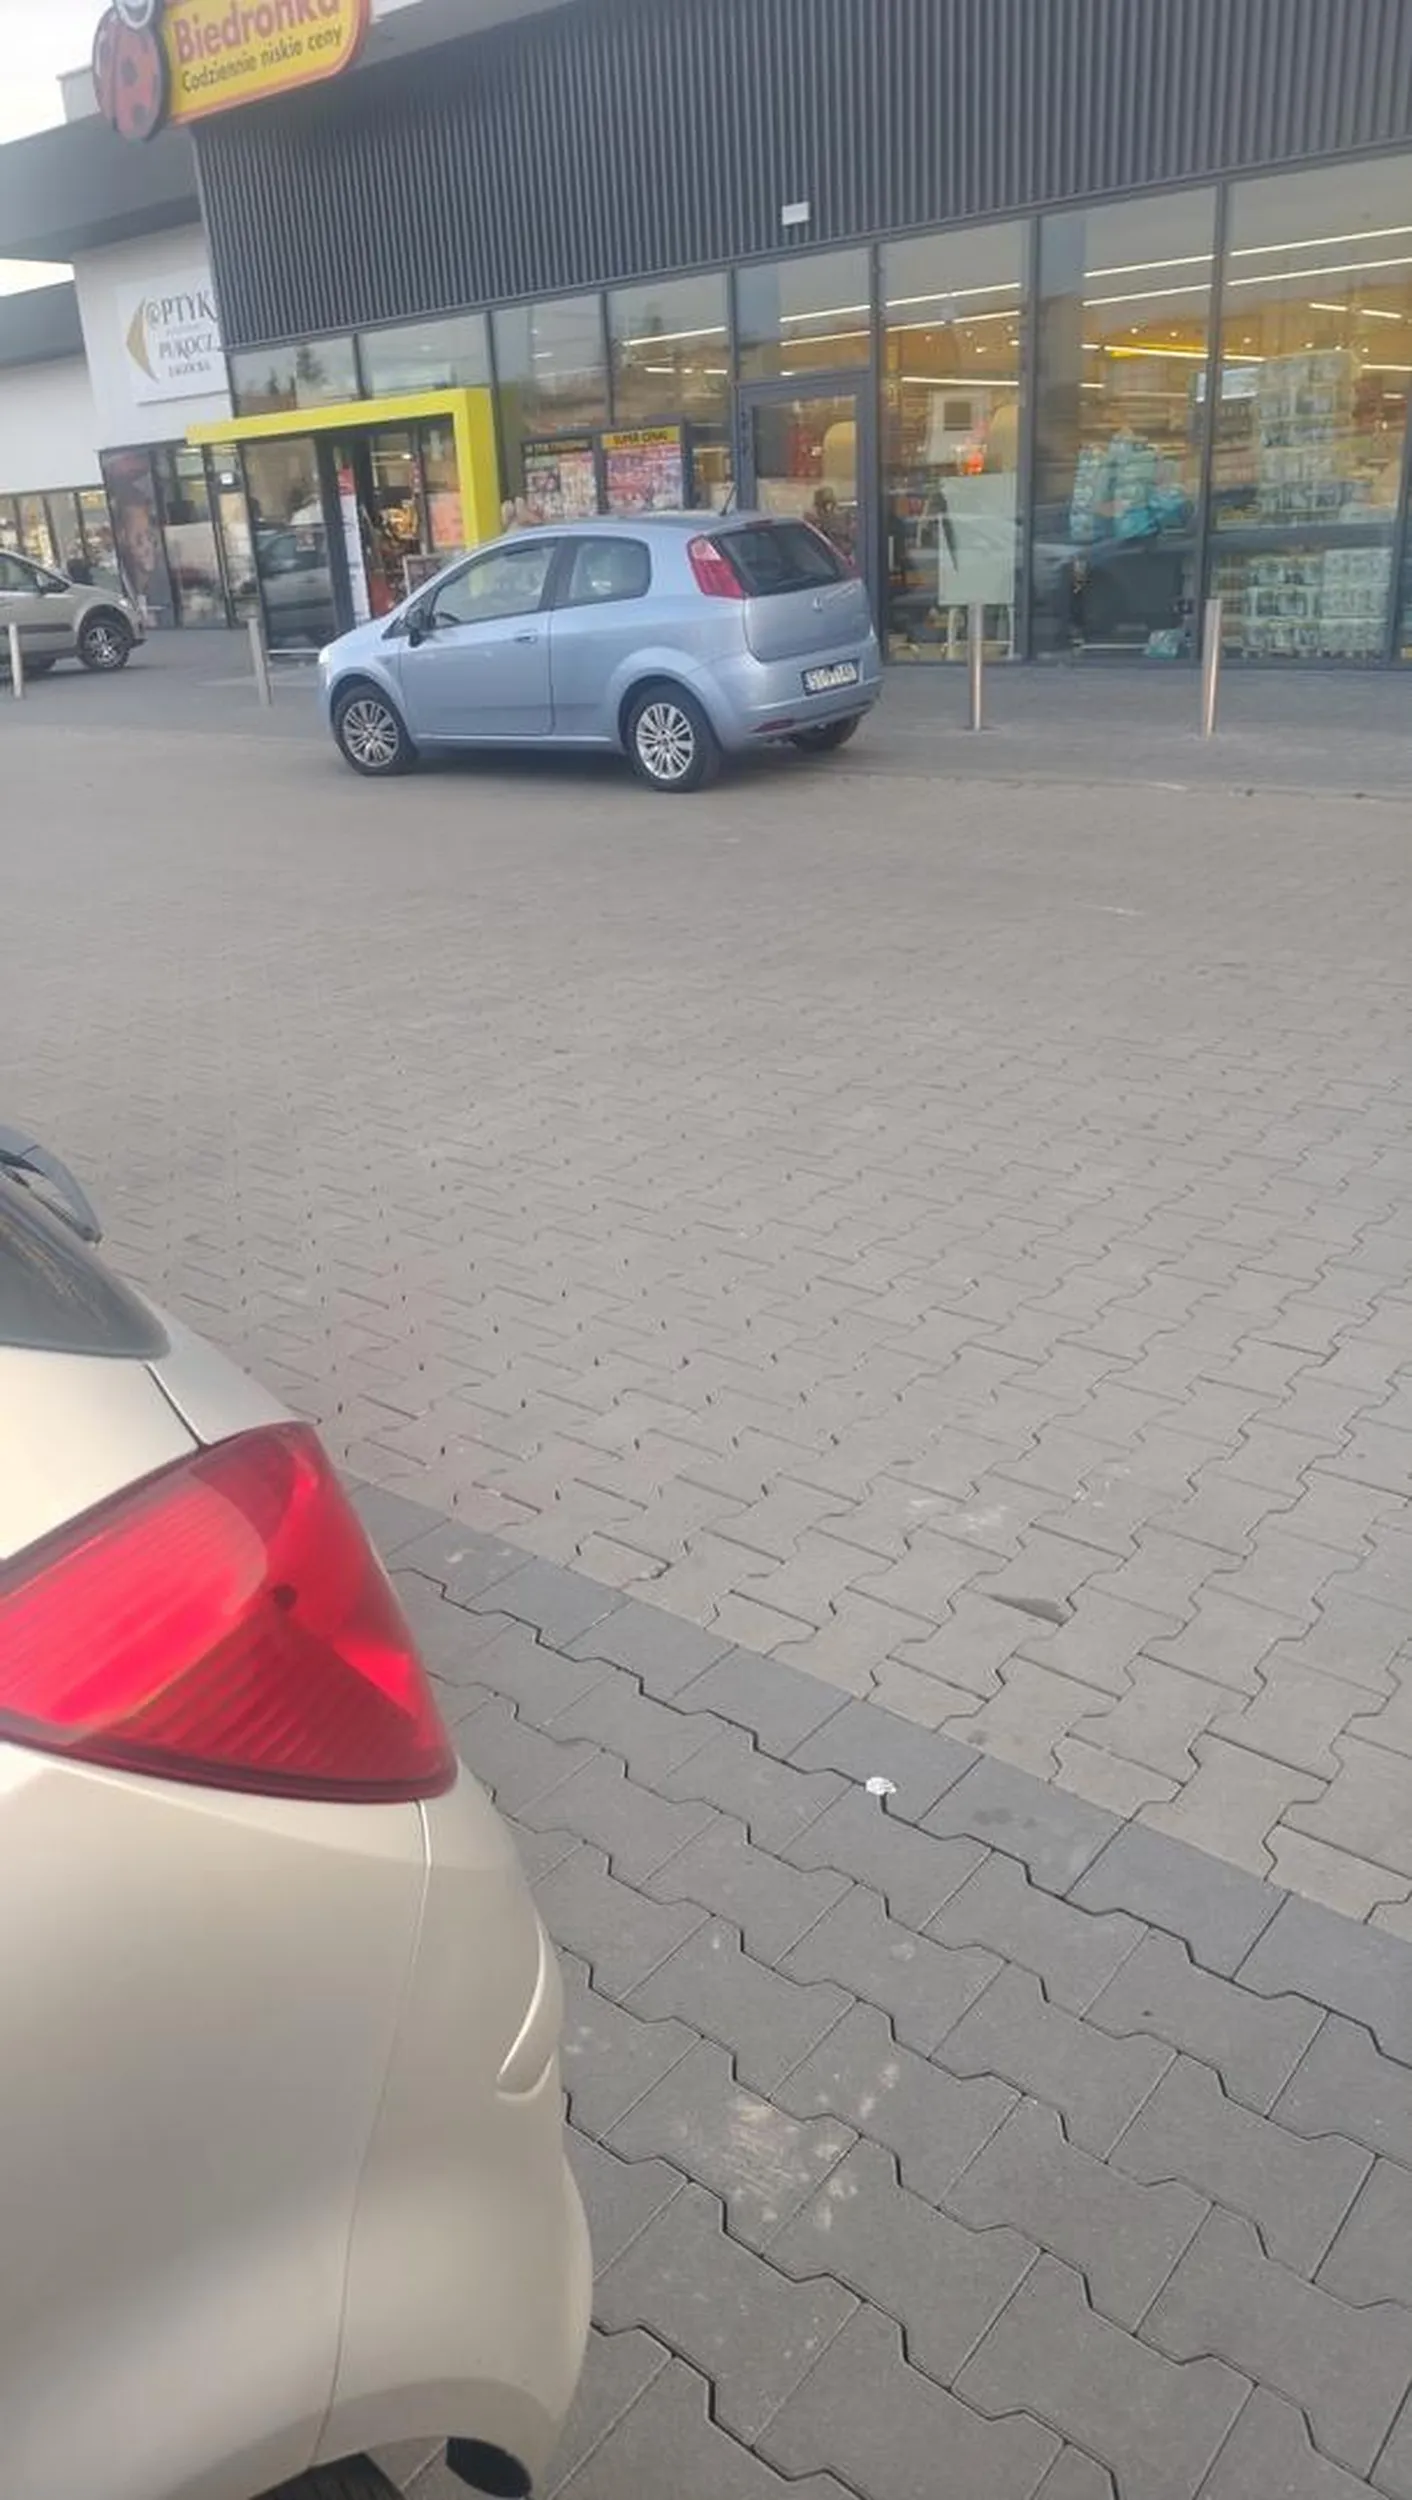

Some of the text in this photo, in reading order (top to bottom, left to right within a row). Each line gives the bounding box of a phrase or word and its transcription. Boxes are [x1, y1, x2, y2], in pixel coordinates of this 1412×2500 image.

[181, 24, 343, 94] Codziennie niskie ceny
